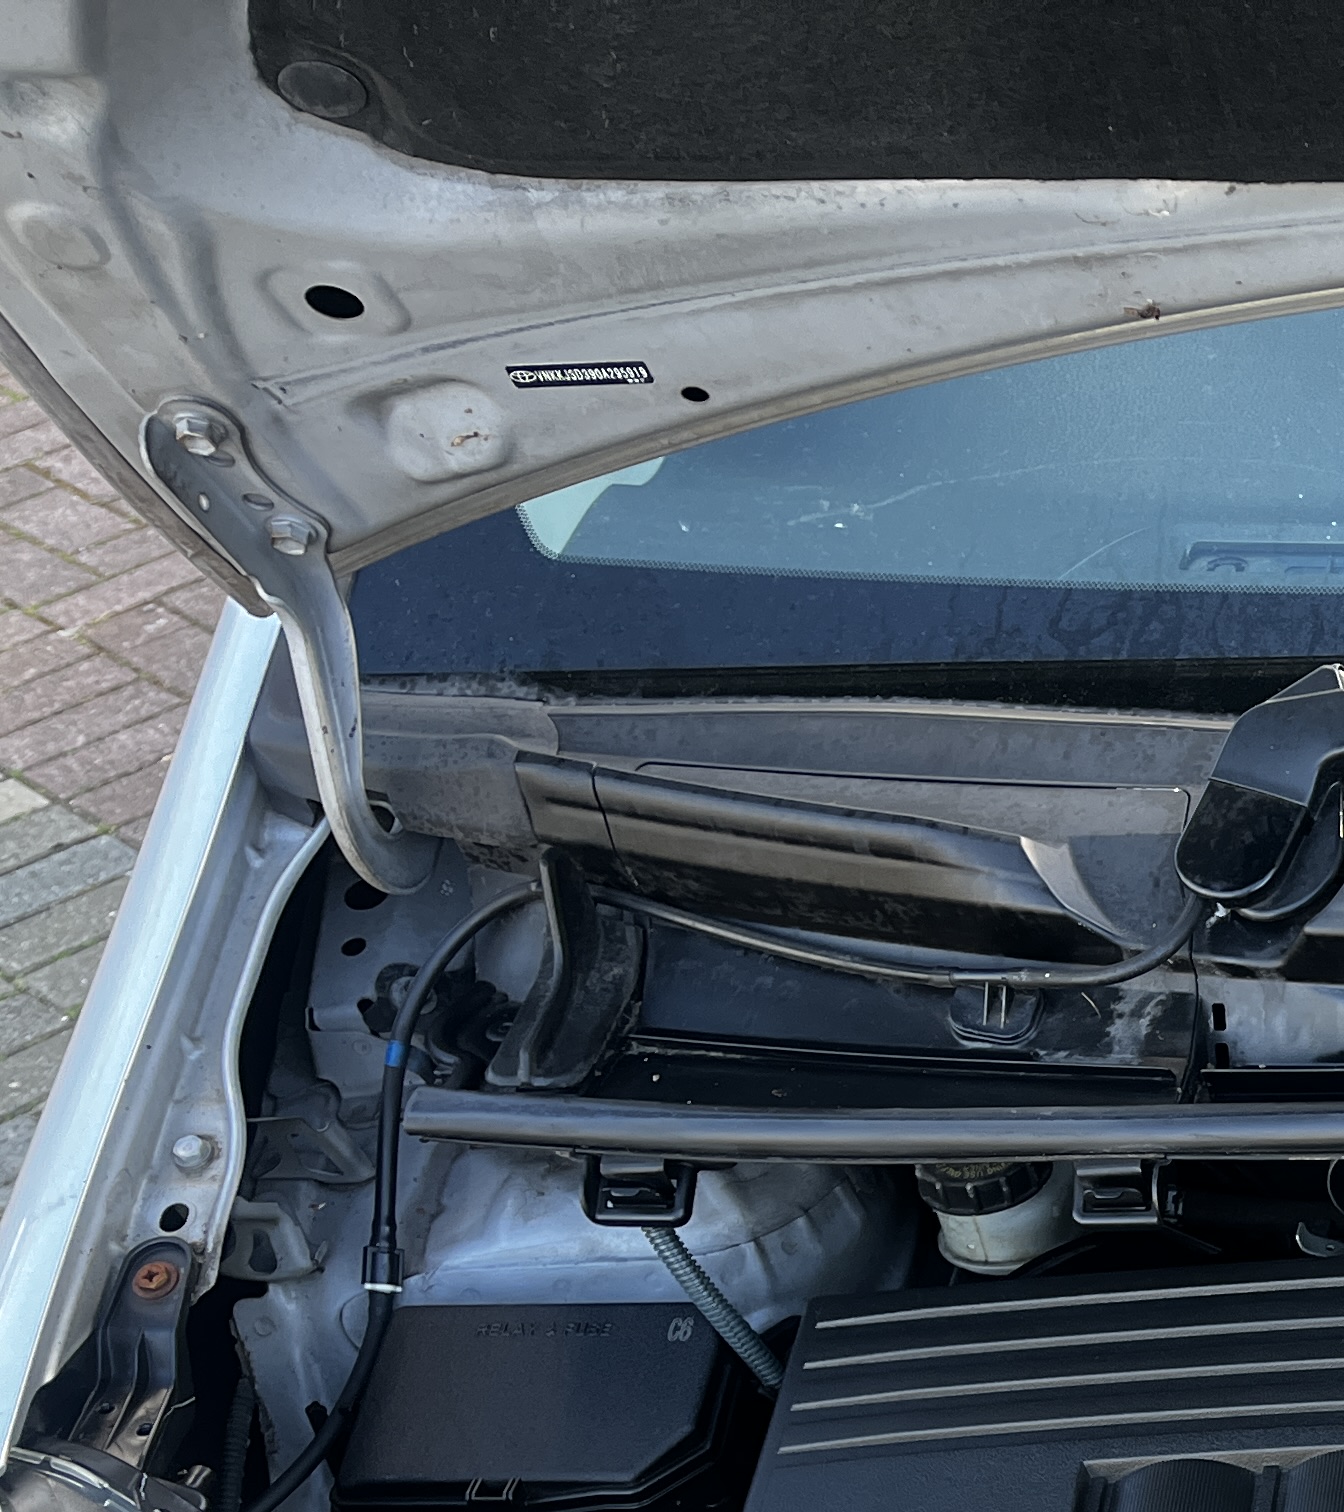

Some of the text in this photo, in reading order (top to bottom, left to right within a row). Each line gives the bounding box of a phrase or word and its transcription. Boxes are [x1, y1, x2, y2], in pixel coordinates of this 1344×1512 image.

[477, 1321, 536, 1337] RELAY
[565, 1322, 613, 1337] FUSE
[667, 1316, 695, 1342] C6
